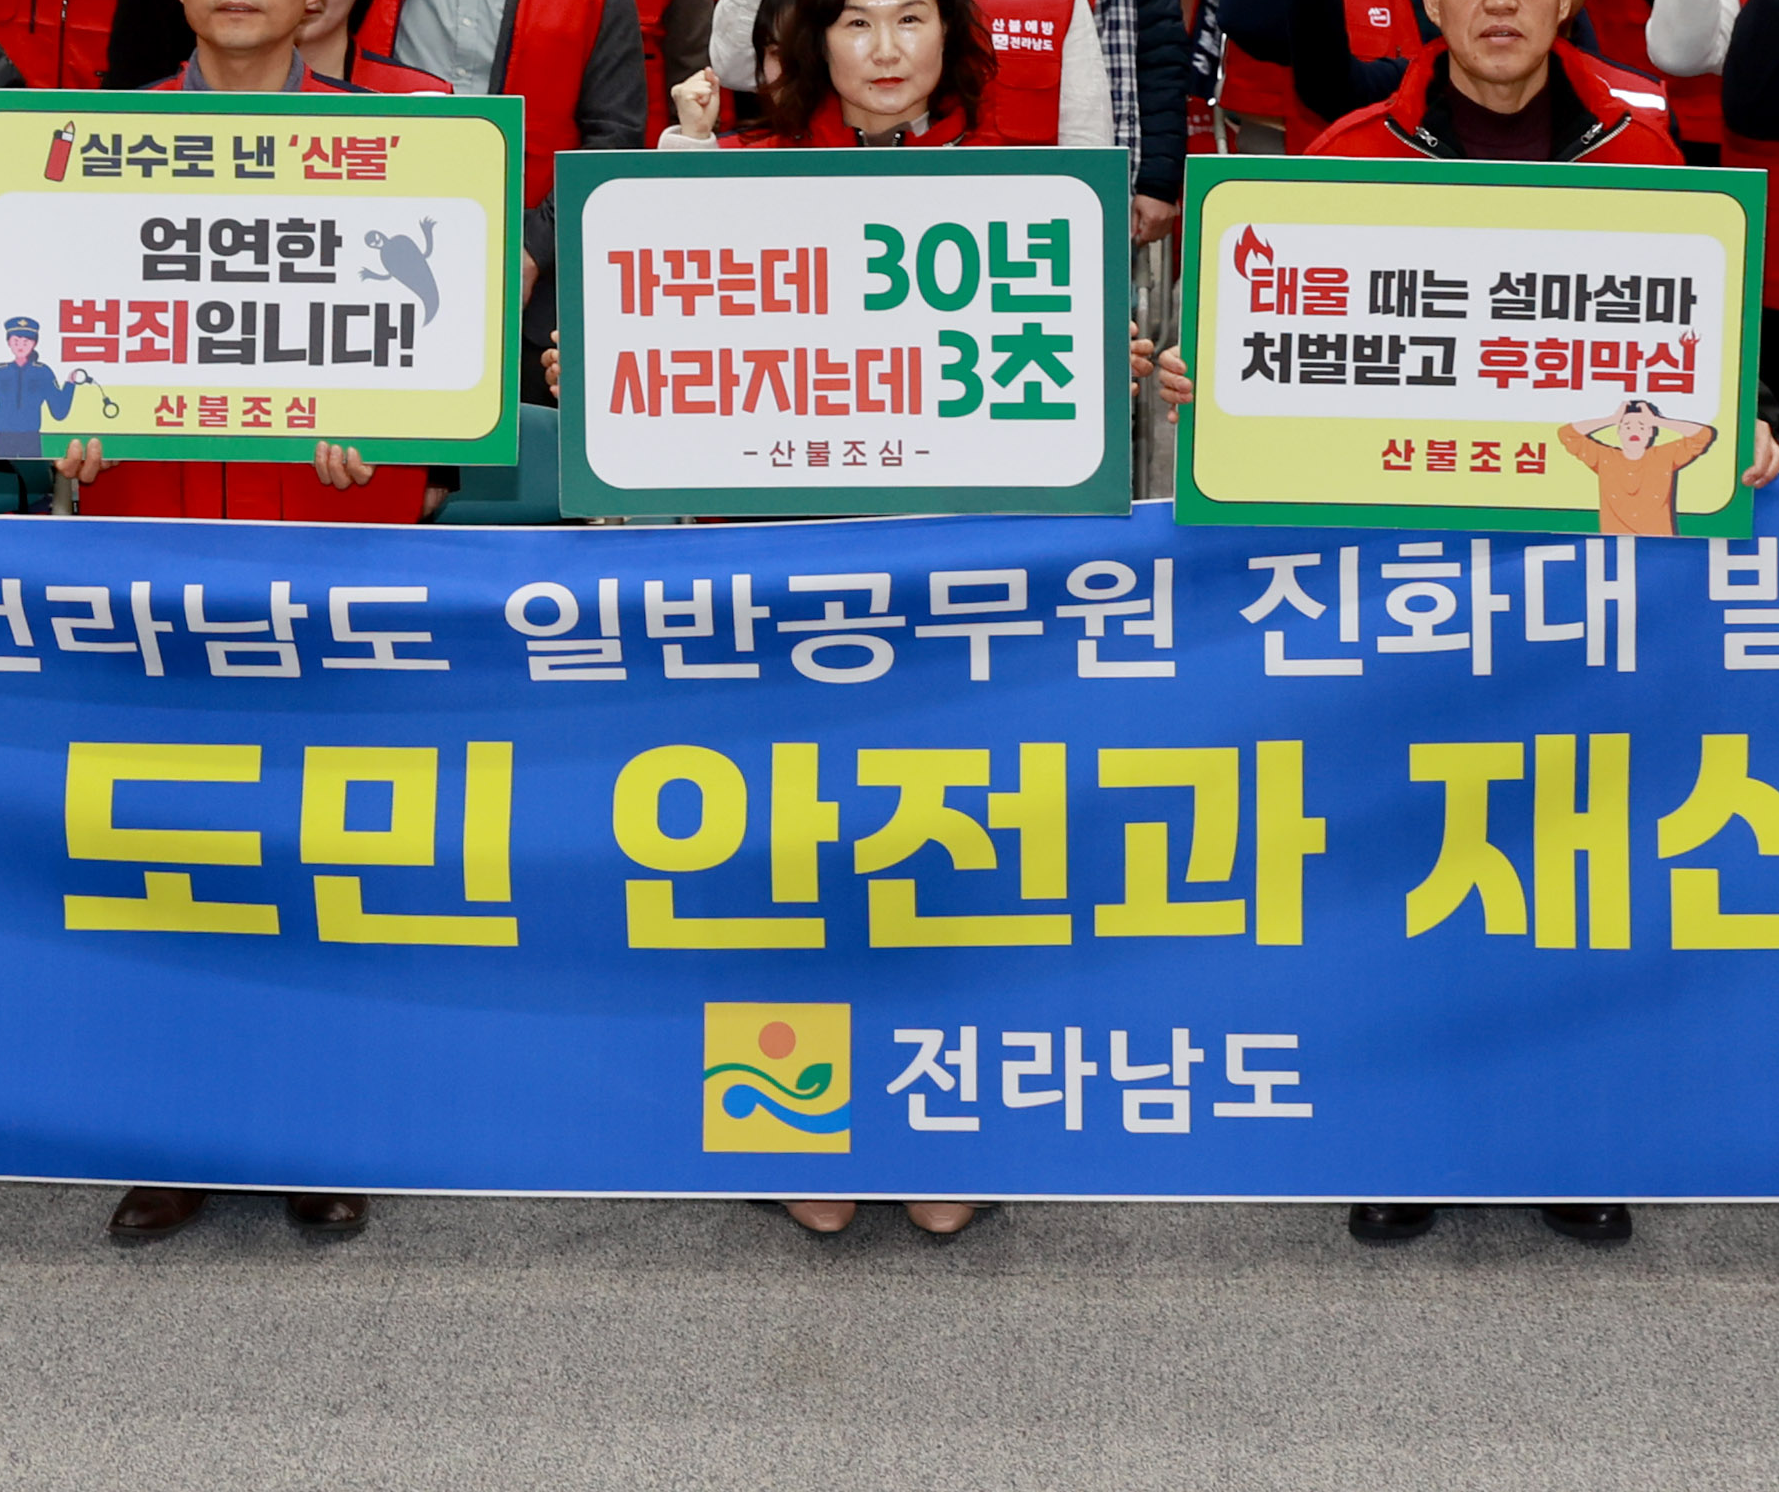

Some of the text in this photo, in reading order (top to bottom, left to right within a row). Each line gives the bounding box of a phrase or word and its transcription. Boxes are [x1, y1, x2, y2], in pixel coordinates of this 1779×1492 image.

[992, 19, 1054, 36] 산불예방
[1009, 36, 1054, 52] 전라남도
[79, 132, 216, 180] 실수로
[232, 134, 276, 180] 낸
[139, 216, 343, 285] 엄연한
[607, 218, 1073, 317] 가꾸는데 30년
[1248, 265, 1698, 326] 태울 때는 설마설마
[58, 297, 416, 368] 범죄입니다!
[1240, 331, 1698, 395] 처벌받고 후회막심
[608, 322, 1077, 421] 사라지는데 3초
[153, 394, 319, 429] 산불조심
[1380, 439, 1548, 475] 산불조심
[504, 557, 1177, 685] 일반공무원
[1238, 536, 1637, 677] 진화대
[65, 741, 519, 946] 도민
[614, 740, 1326, 949] 안전과
[886, 1025, 1314, 1134] 전라남도
